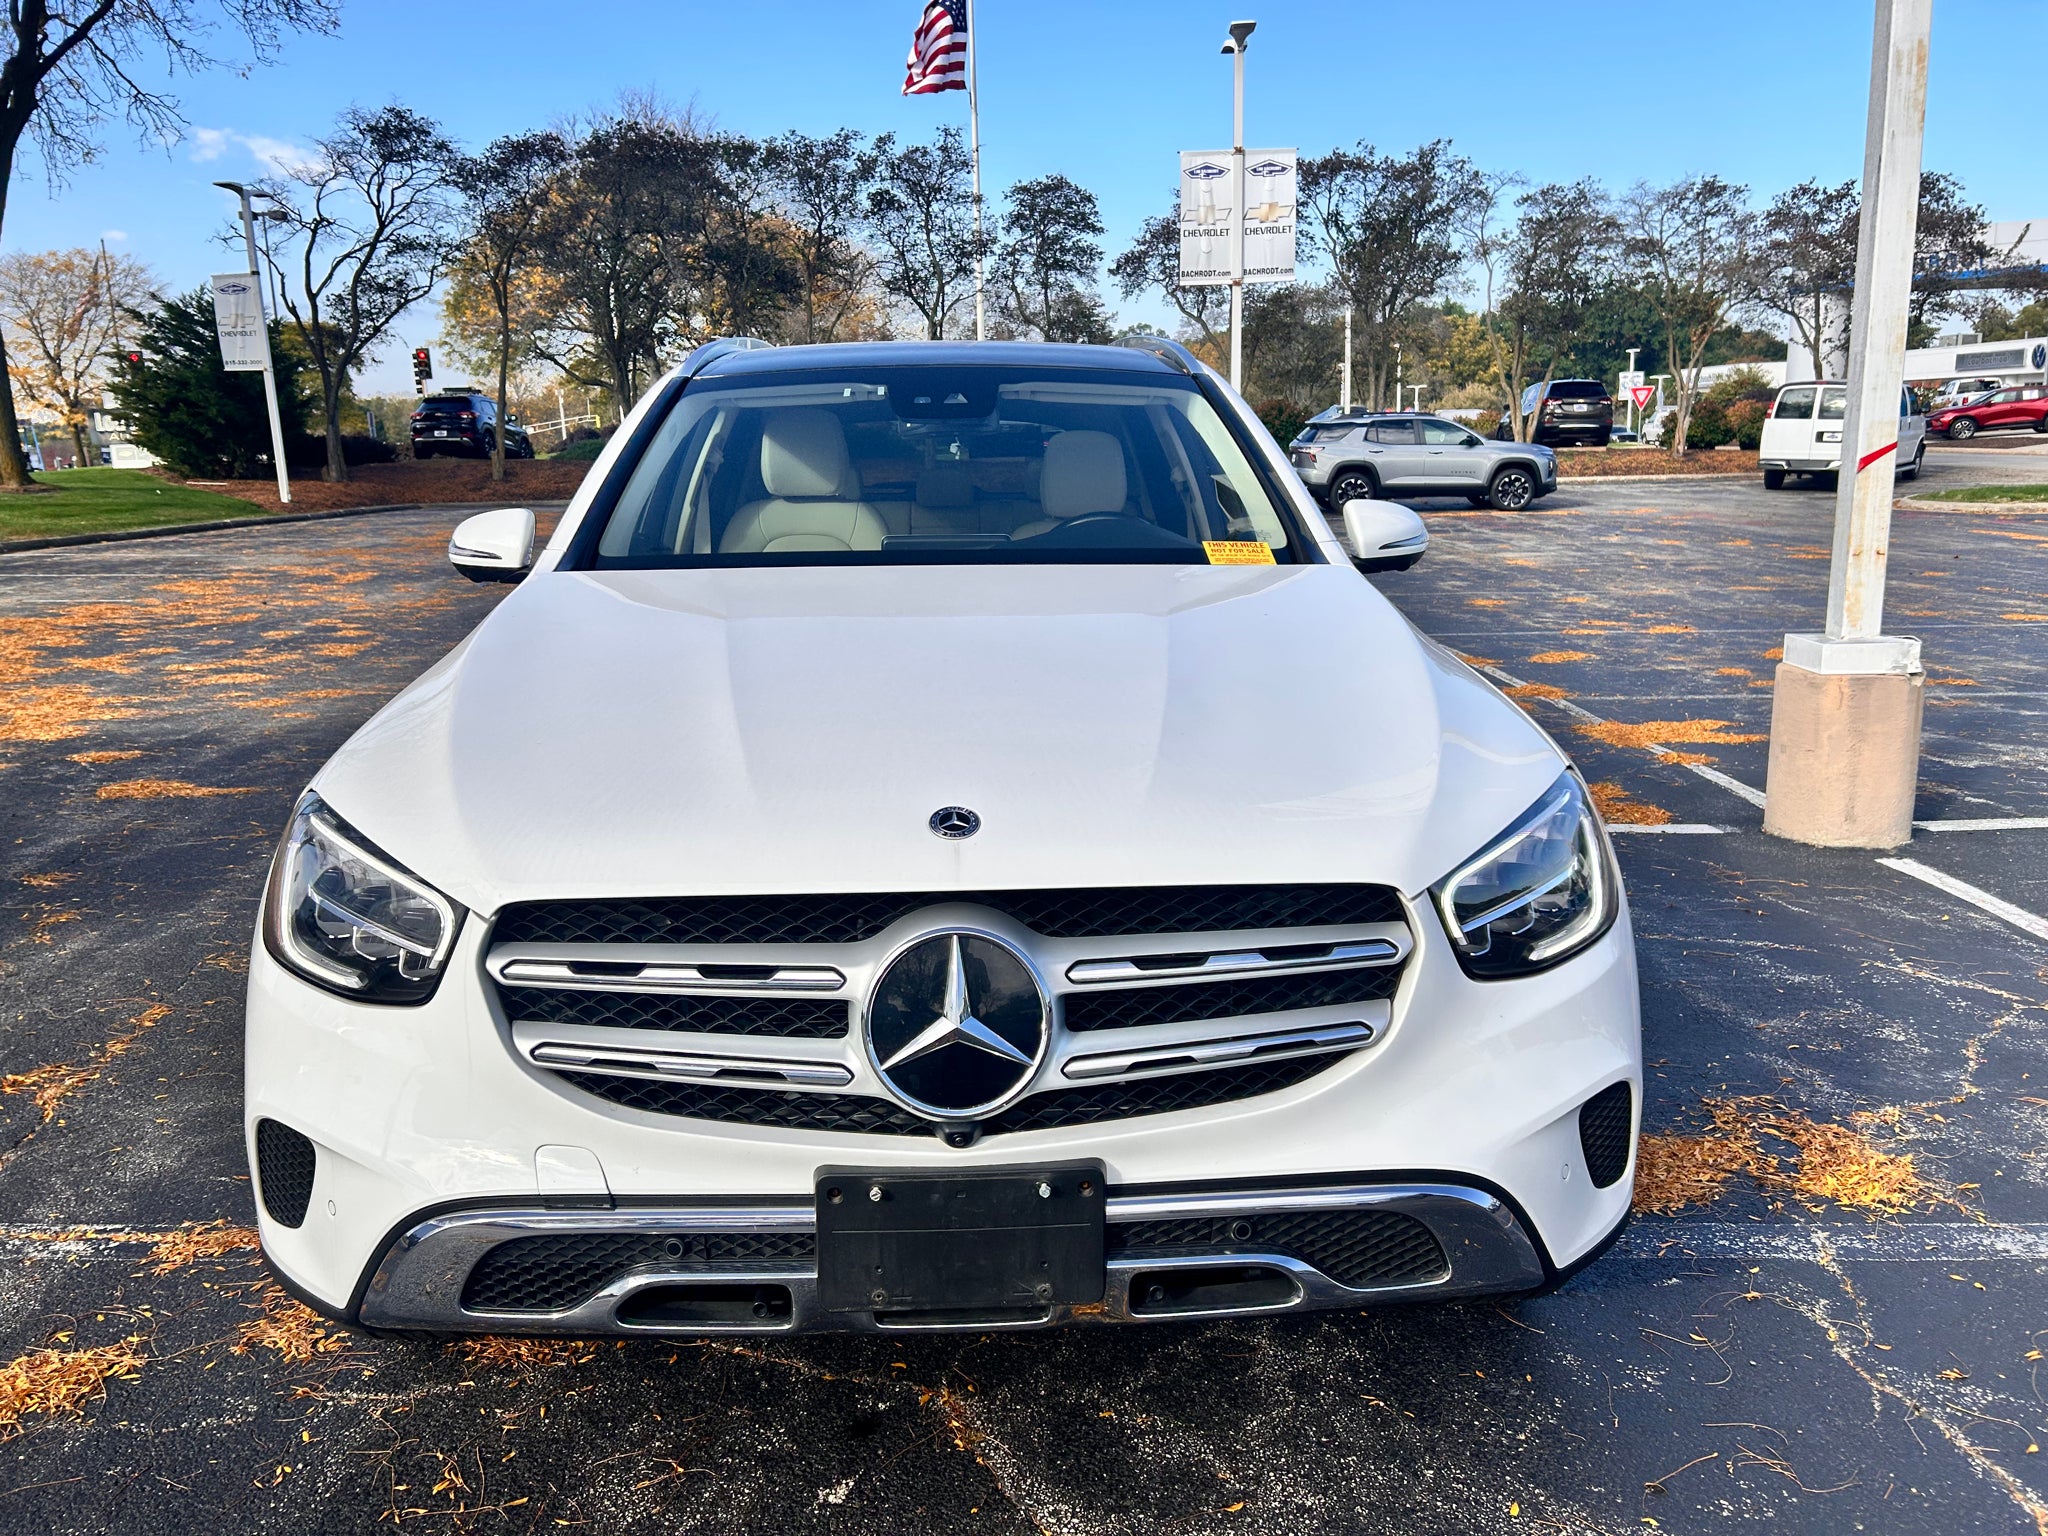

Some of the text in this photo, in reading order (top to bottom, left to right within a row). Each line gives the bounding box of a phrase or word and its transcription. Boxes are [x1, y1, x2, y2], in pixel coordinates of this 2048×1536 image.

[1183, 228, 1230, 238] CHEVROLET
[1244, 225, 1293, 236] CHEVROLET
[1181, 269, 1231, 278] BACHRODT.com
[1243, 267, 1294, 276] BACHRODT.com
[220, 330, 257, 338] CHEVROLET
